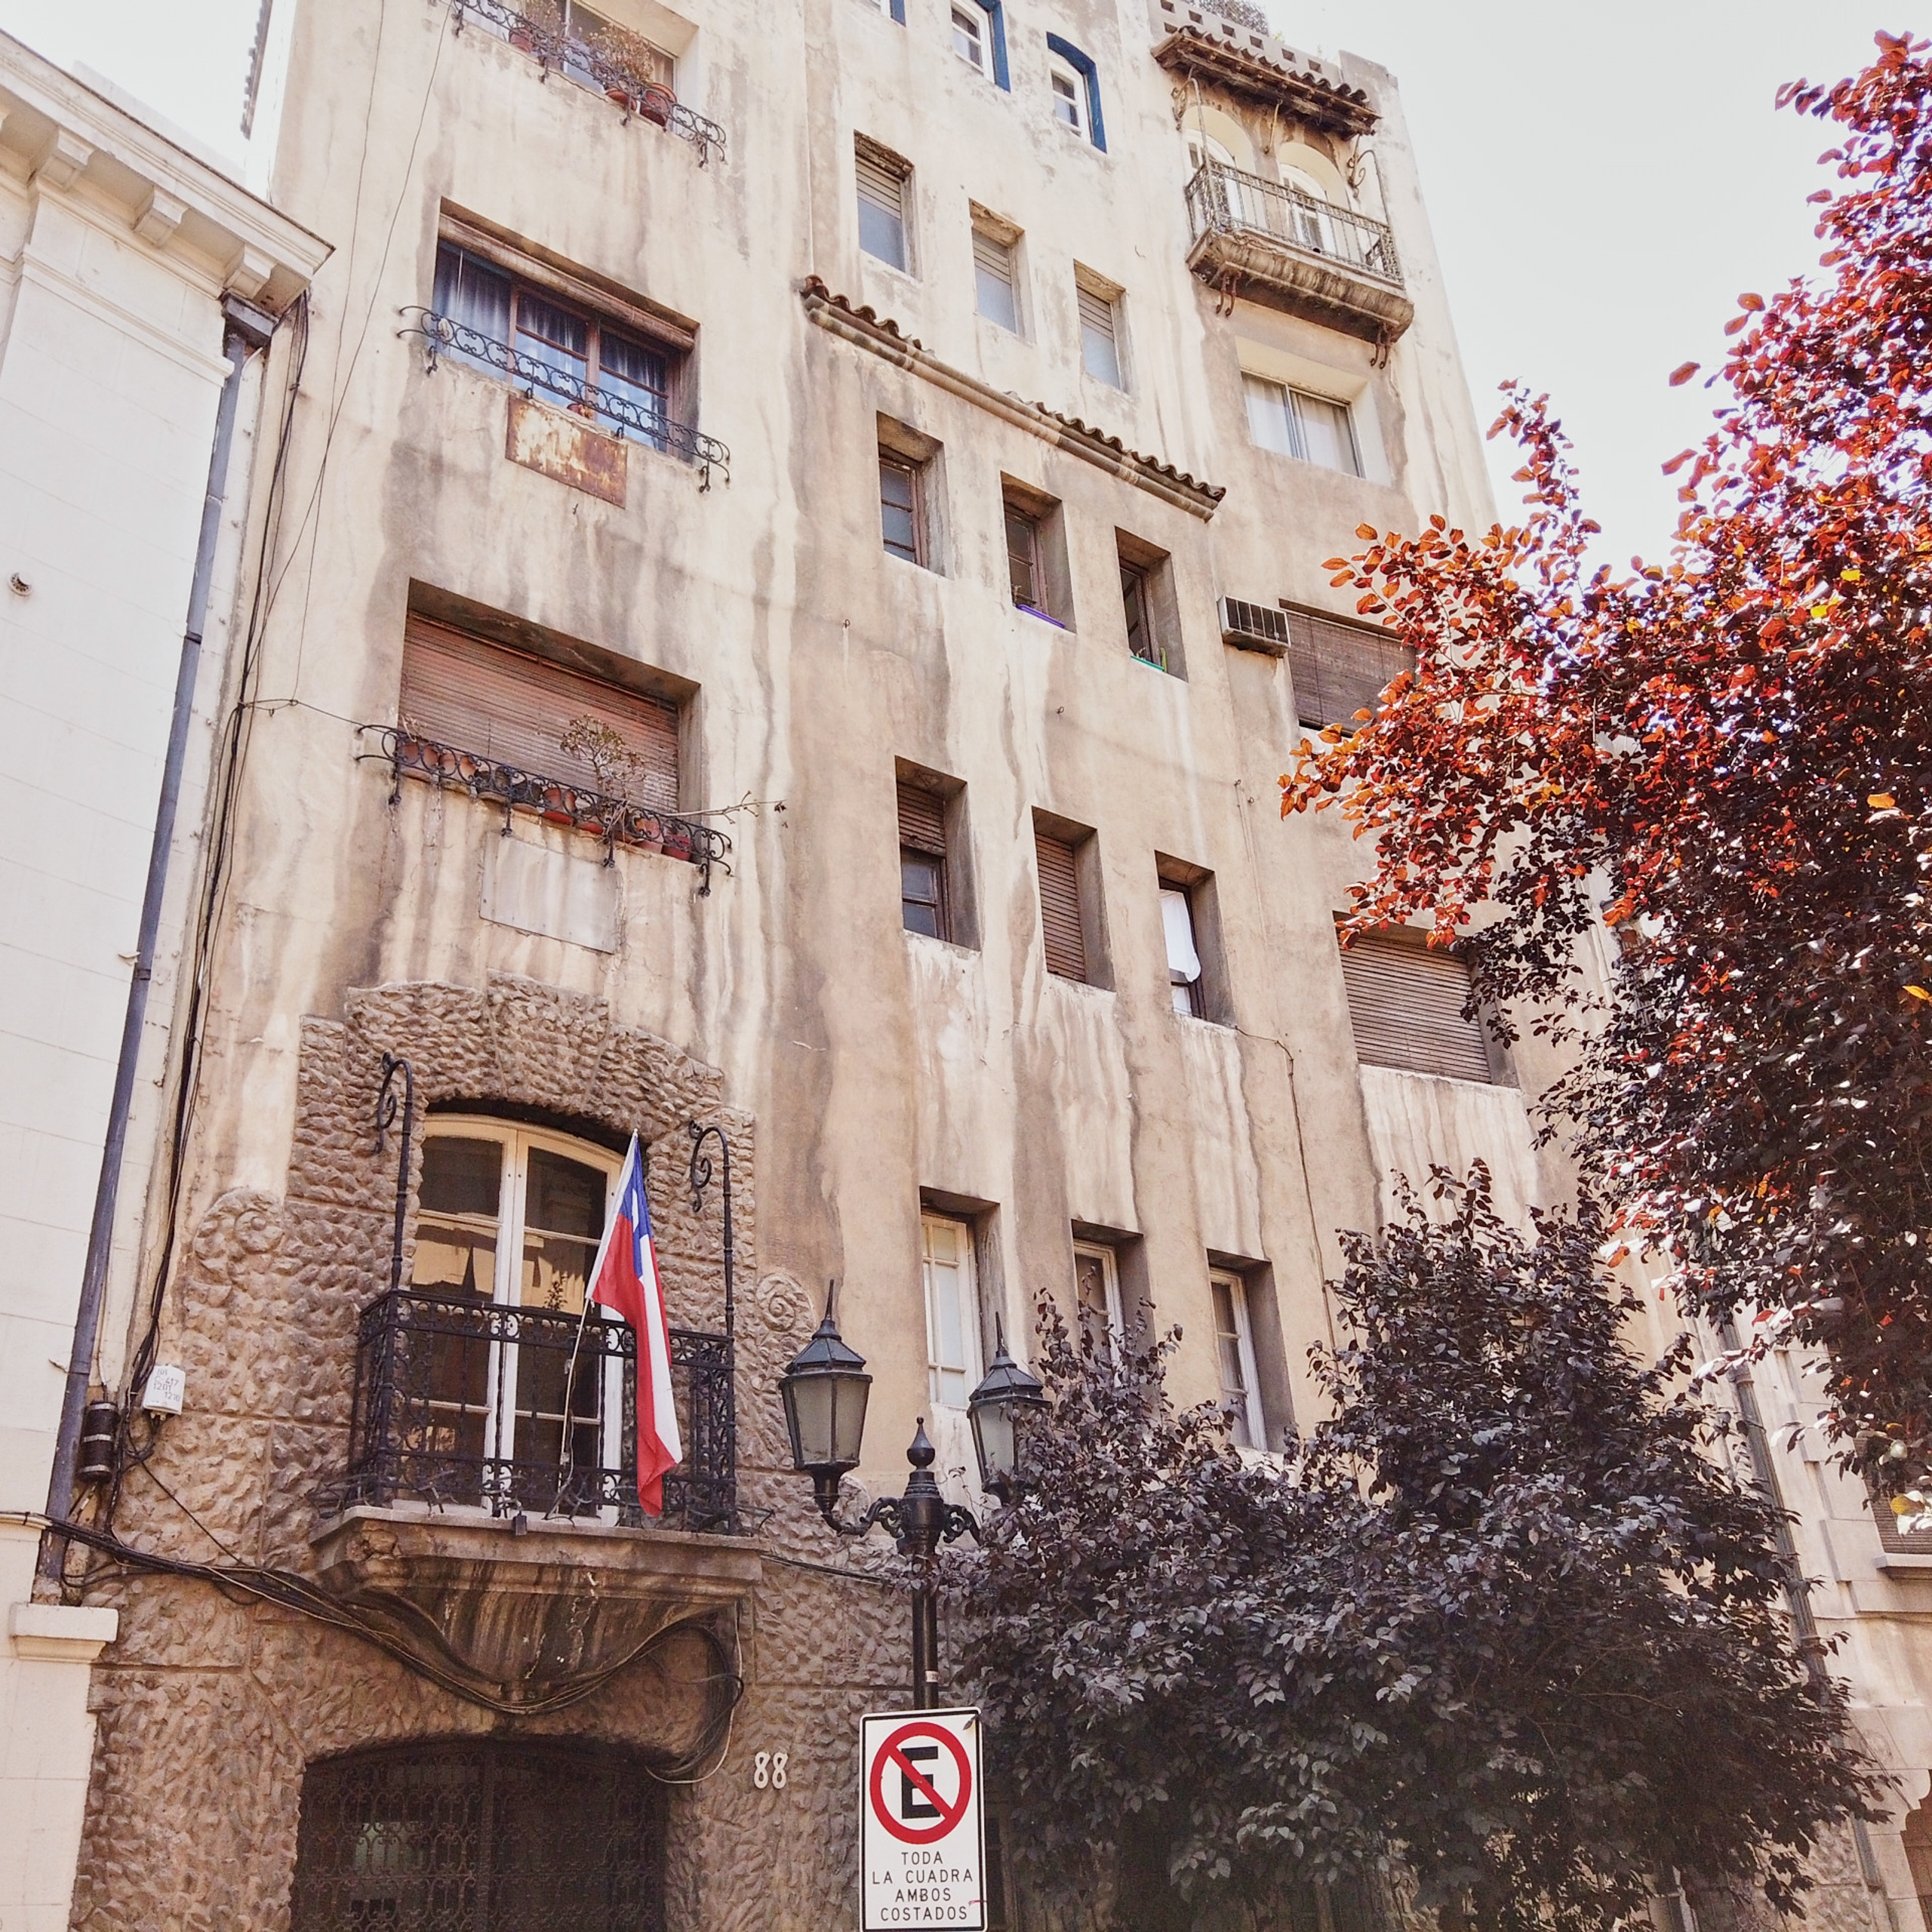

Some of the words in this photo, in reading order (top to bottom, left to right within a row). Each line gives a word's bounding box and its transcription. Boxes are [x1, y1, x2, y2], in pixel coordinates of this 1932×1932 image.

[753, 1752, 789, 1789] 88
[901, 1746, 940, 1819] E
[901, 1851, 943, 1866] TODA
[872, 1871, 893, 1884] LA
[906, 1869, 973, 1884] CUADRA
[895, 1887, 951, 1902] AMBOS
[881, 1906, 967, 1921] COSTADOS
